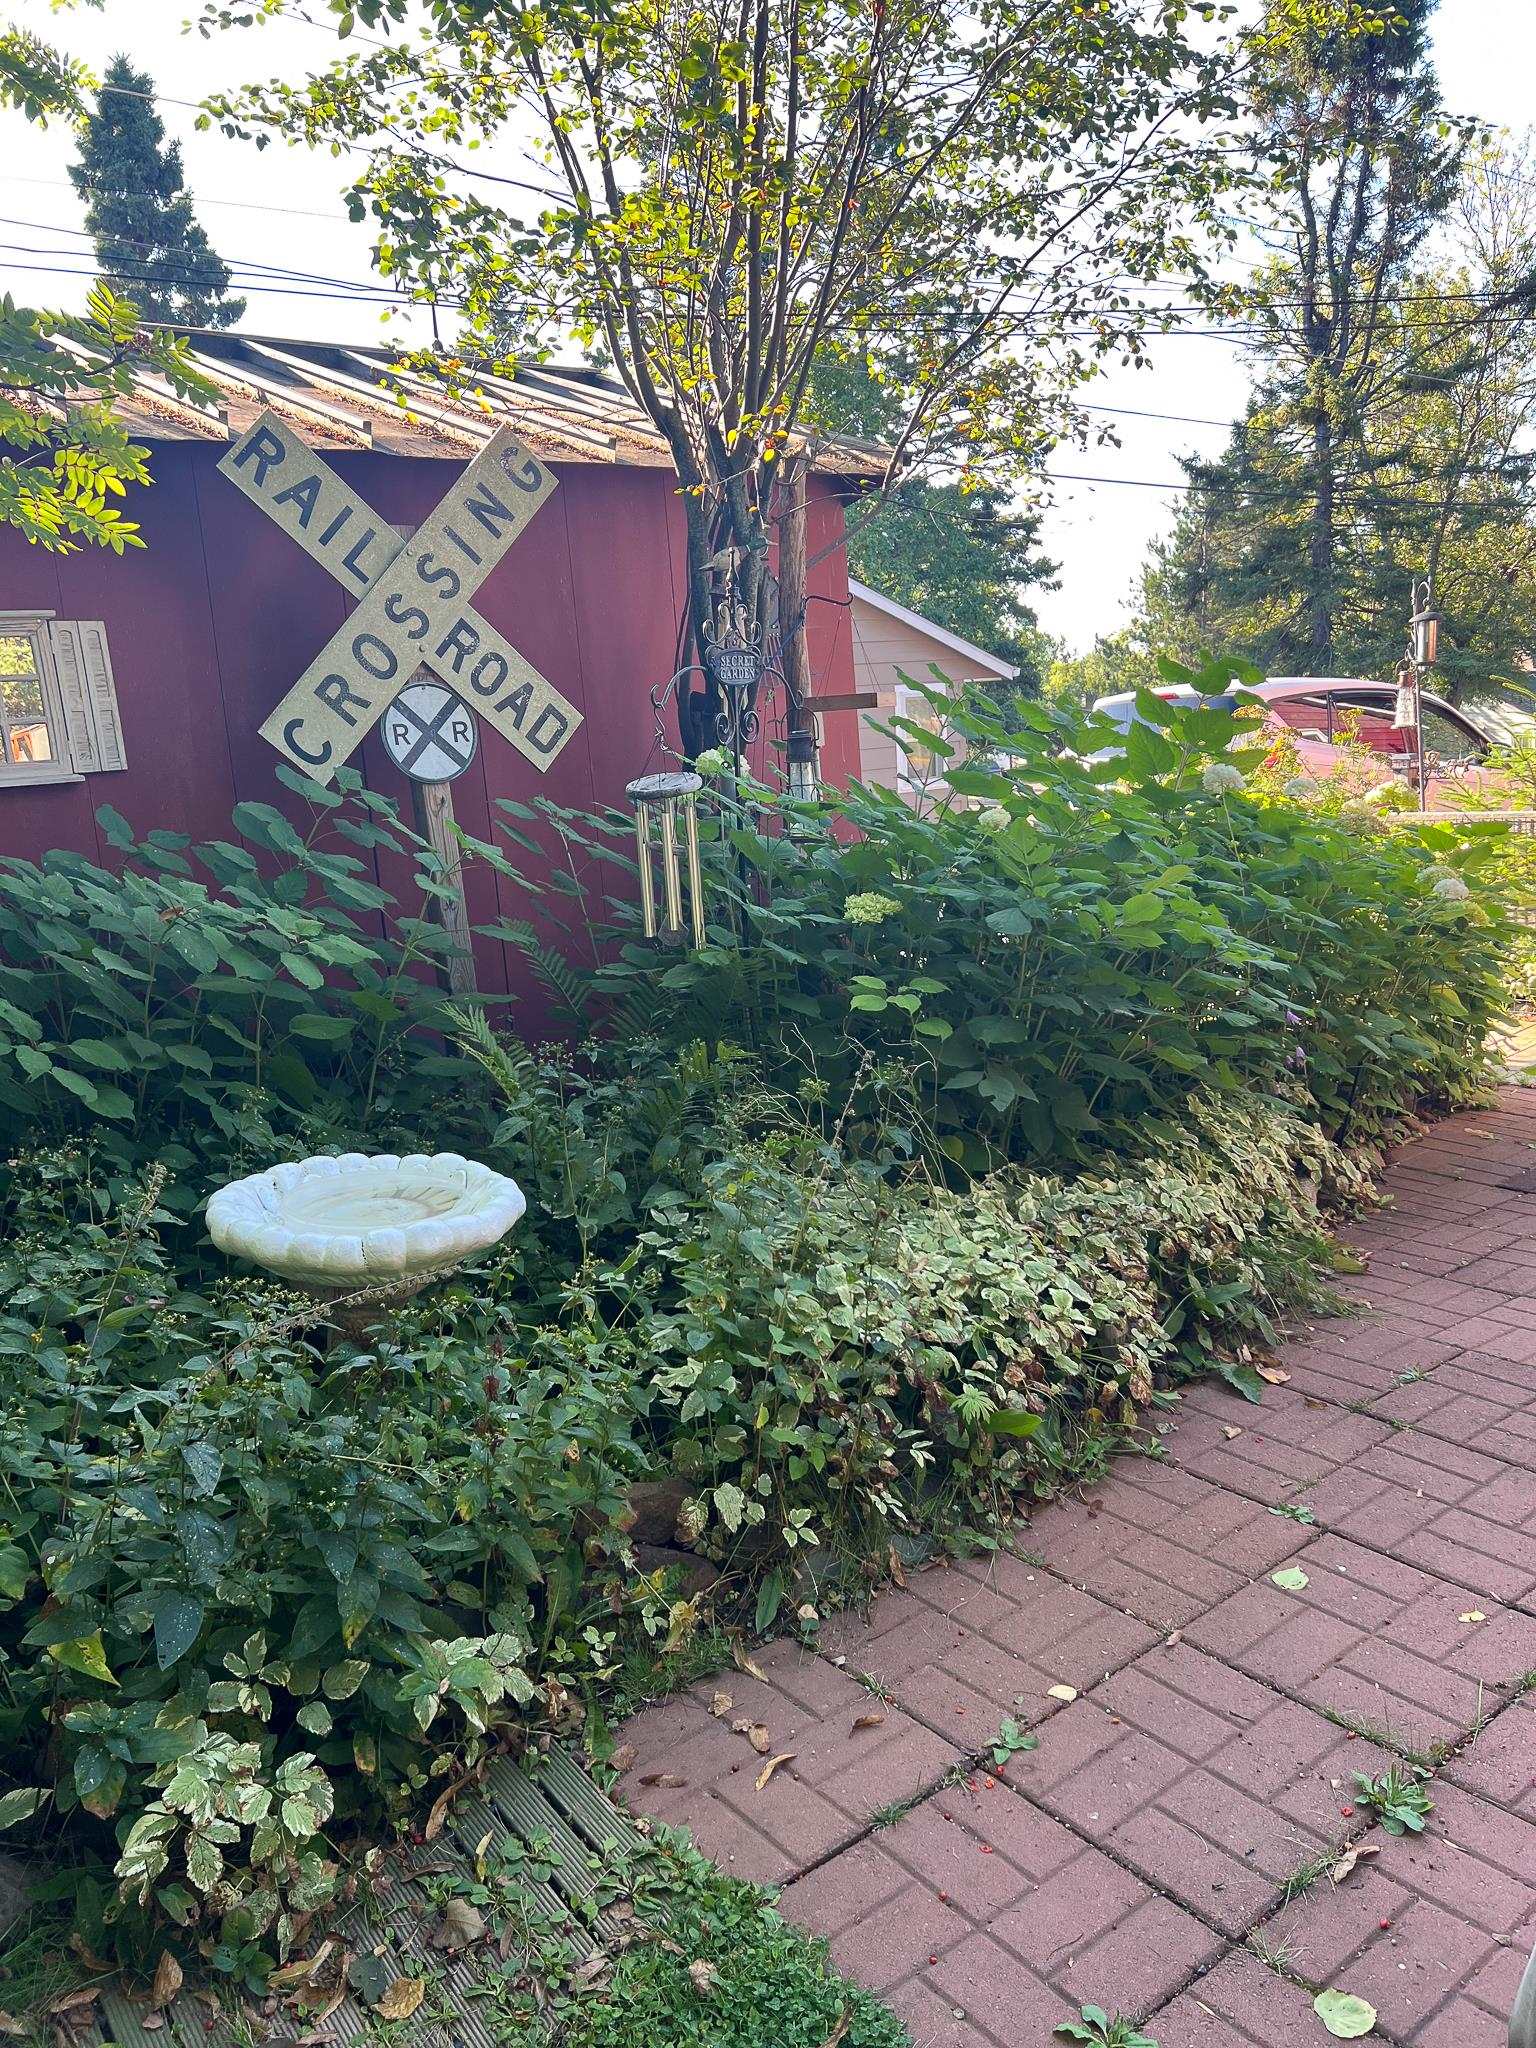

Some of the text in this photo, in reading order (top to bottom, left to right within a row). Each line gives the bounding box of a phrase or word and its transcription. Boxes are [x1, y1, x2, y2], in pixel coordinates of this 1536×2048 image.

[232, 425, 569, 755] RAIL ROAD
[282, 446, 544, 766] CROSSING
[720, 655, 755, 667] SECRET
[720, 668, 755, 680] GARDEN
[391, 720, 470, 746] R R
